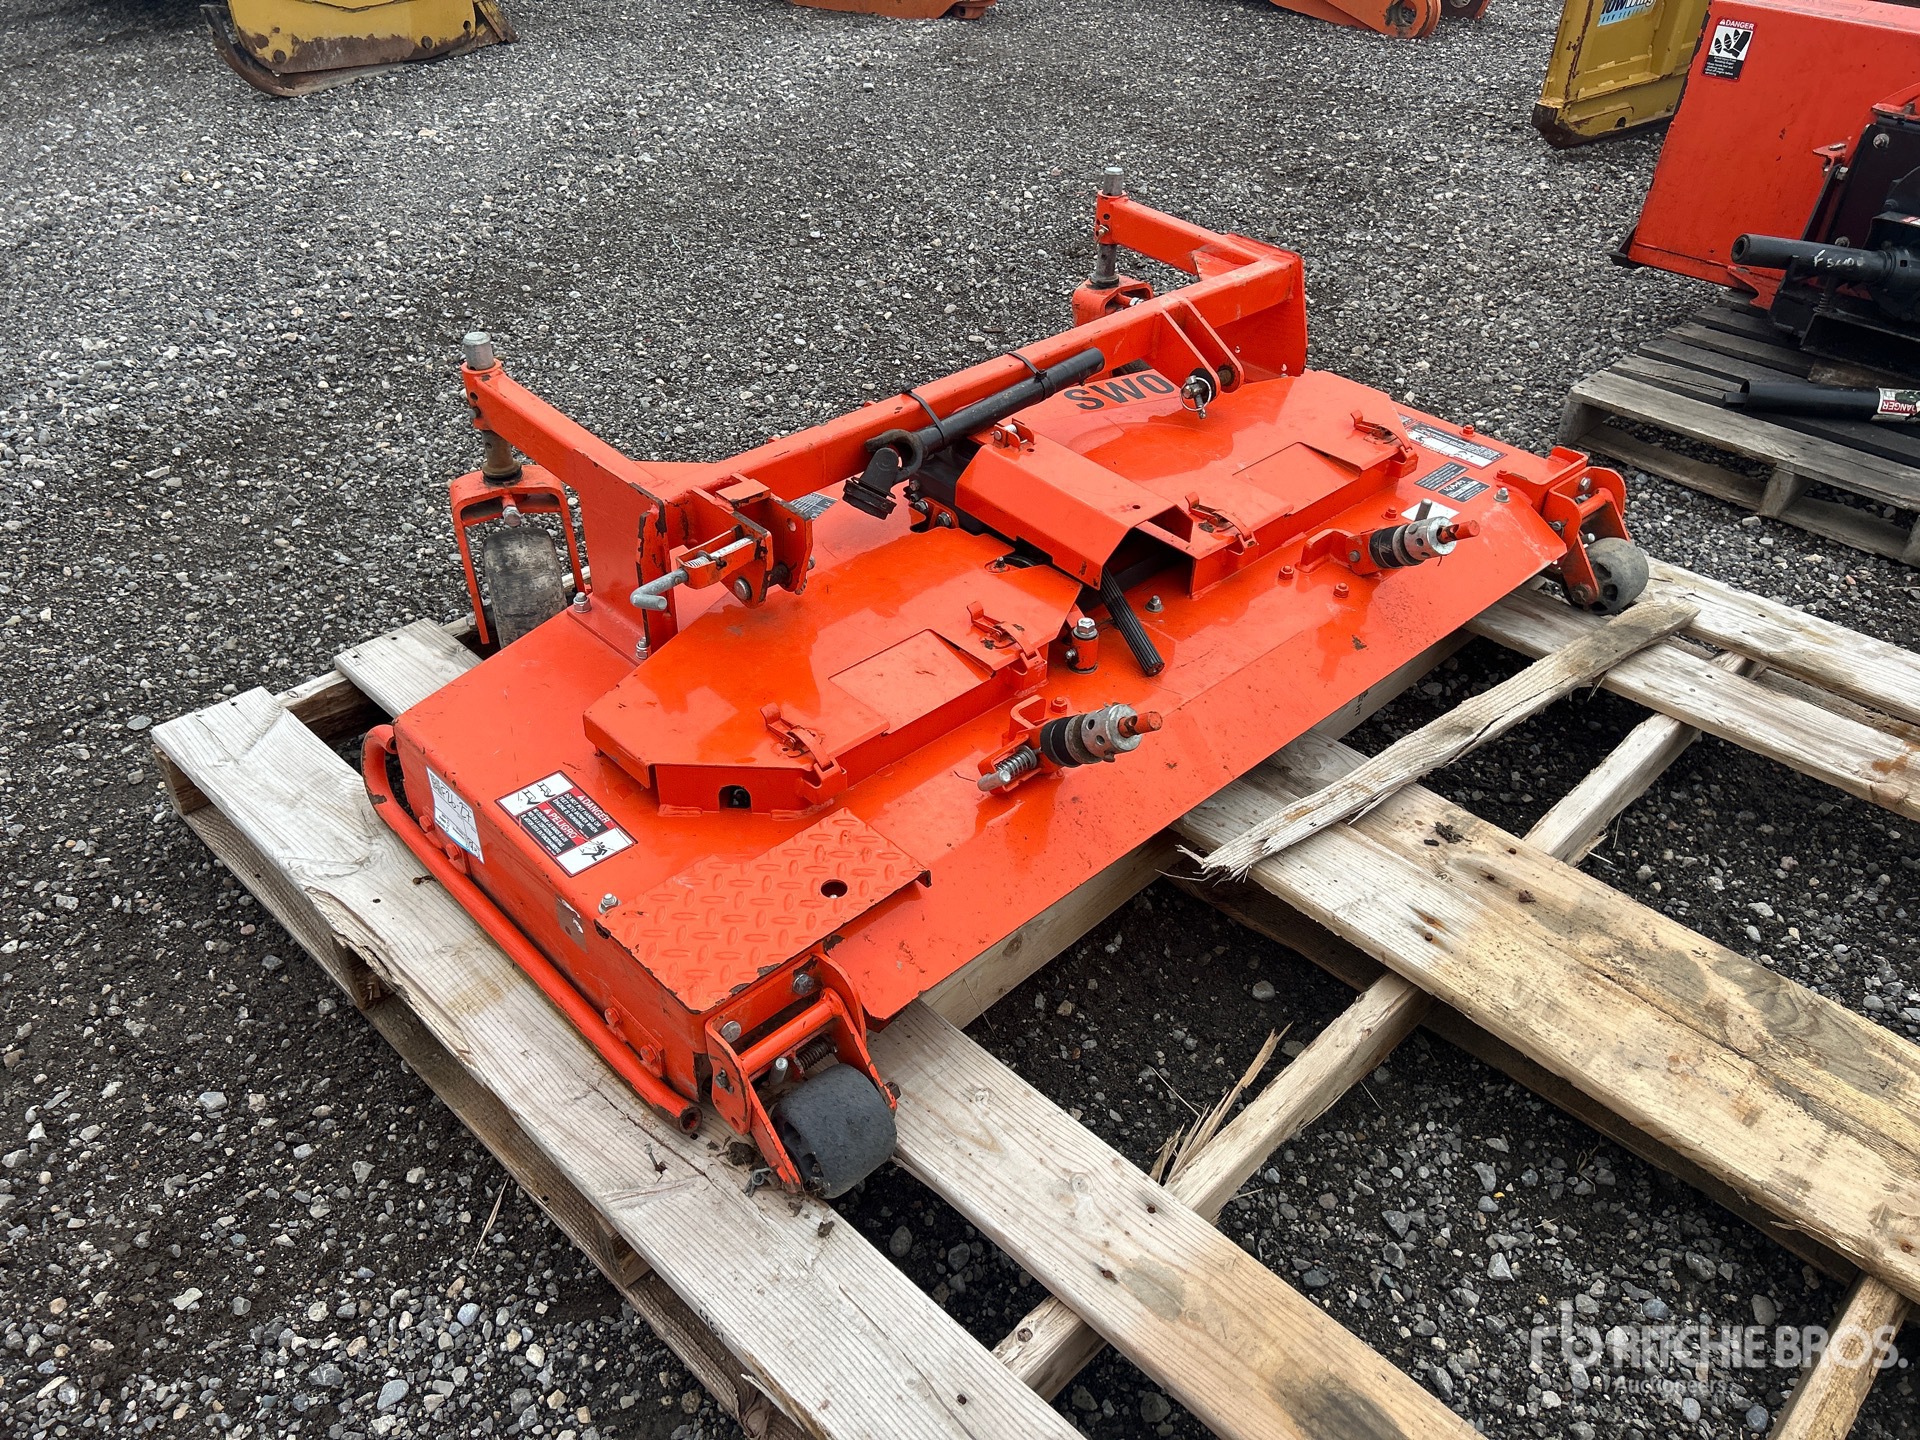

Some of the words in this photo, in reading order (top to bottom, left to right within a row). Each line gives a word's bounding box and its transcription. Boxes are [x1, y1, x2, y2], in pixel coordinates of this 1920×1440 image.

[1725, 19, 1755, 30] DANGER
[580, 797, 611, 823] DANGER
[547, 812, 578, 839] PELIGRO
